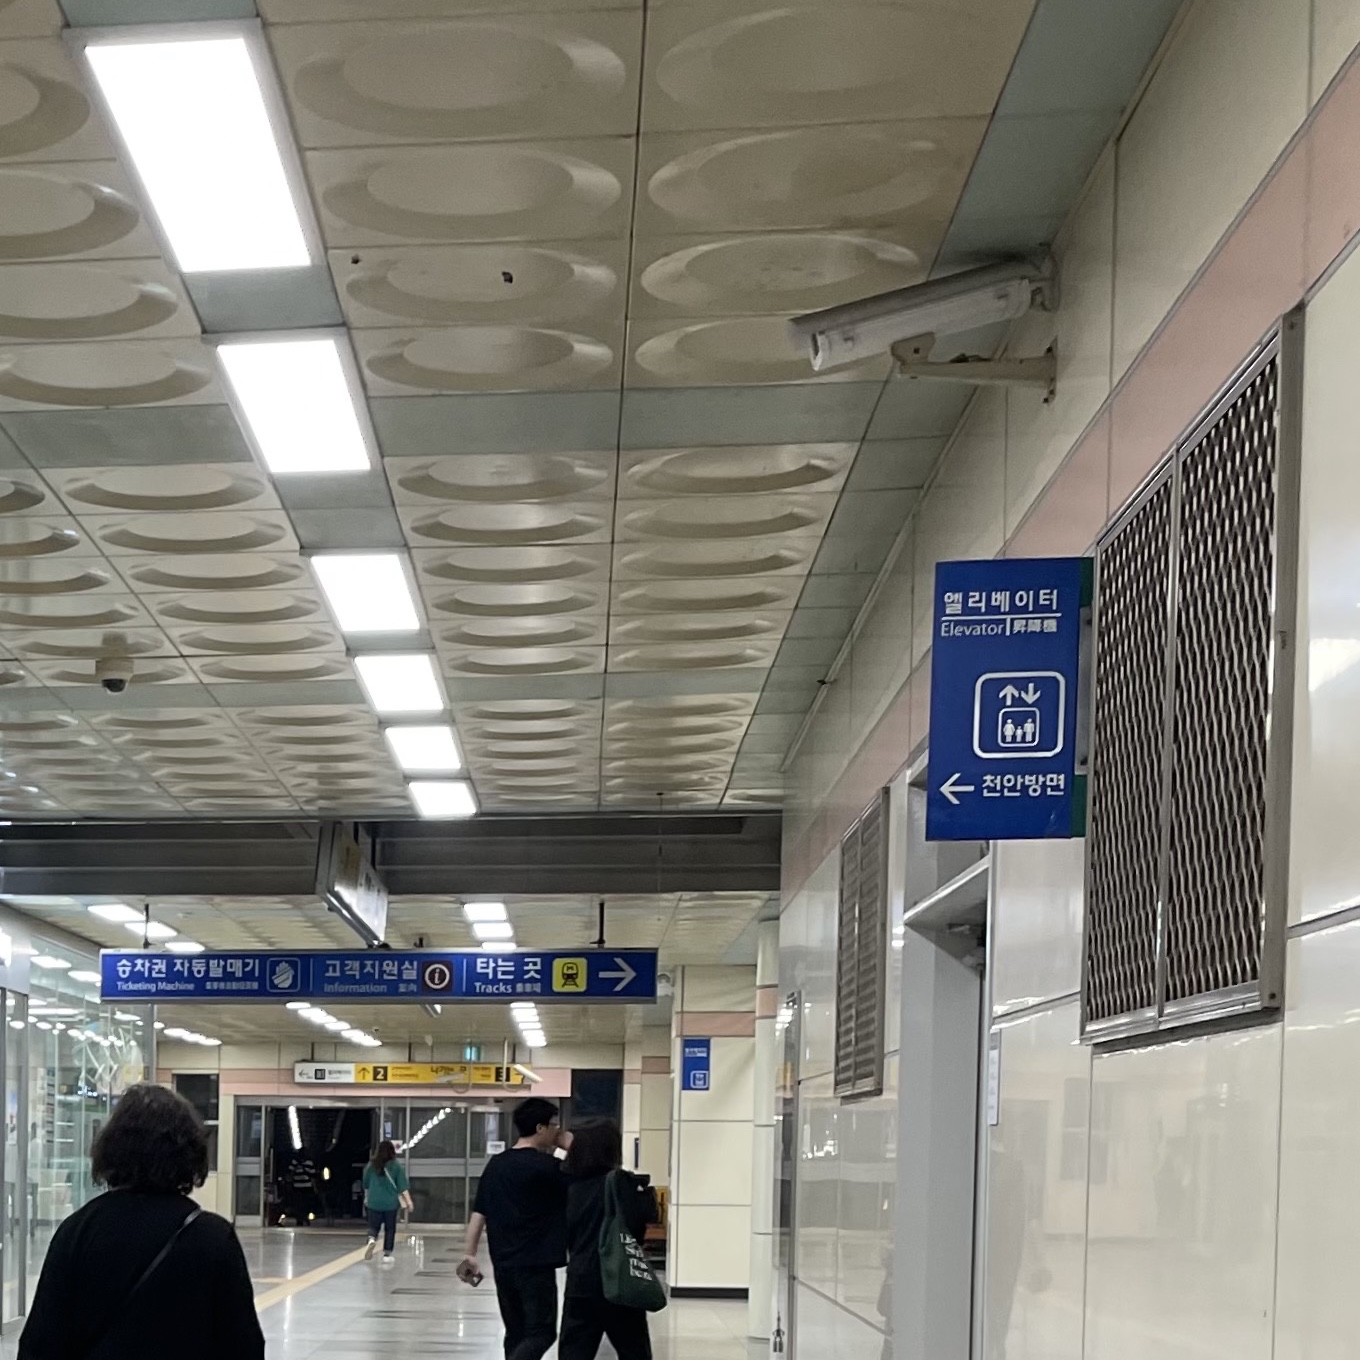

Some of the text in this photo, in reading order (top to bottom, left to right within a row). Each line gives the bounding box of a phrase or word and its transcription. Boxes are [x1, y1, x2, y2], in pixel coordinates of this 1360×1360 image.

[943, 589, 1058, 615] 엘리베이터
[941, 621, 1005, 637] Elevator
[982, 773, 1065, 797] 천안방면
[116, 958, 260, 978] 승차권 자동발매기
[324, 960, 418, 980] 고객지원실
[476, 957, 542, 980] 타는 곳
[116, 981, 156, 992] Ticketing
[157, 981, 195, 991] Machine
[323, 982, 388, 993] Information
[474, 982, 513, 993] Tracks
[375, 1067, 386, 1080] 2
